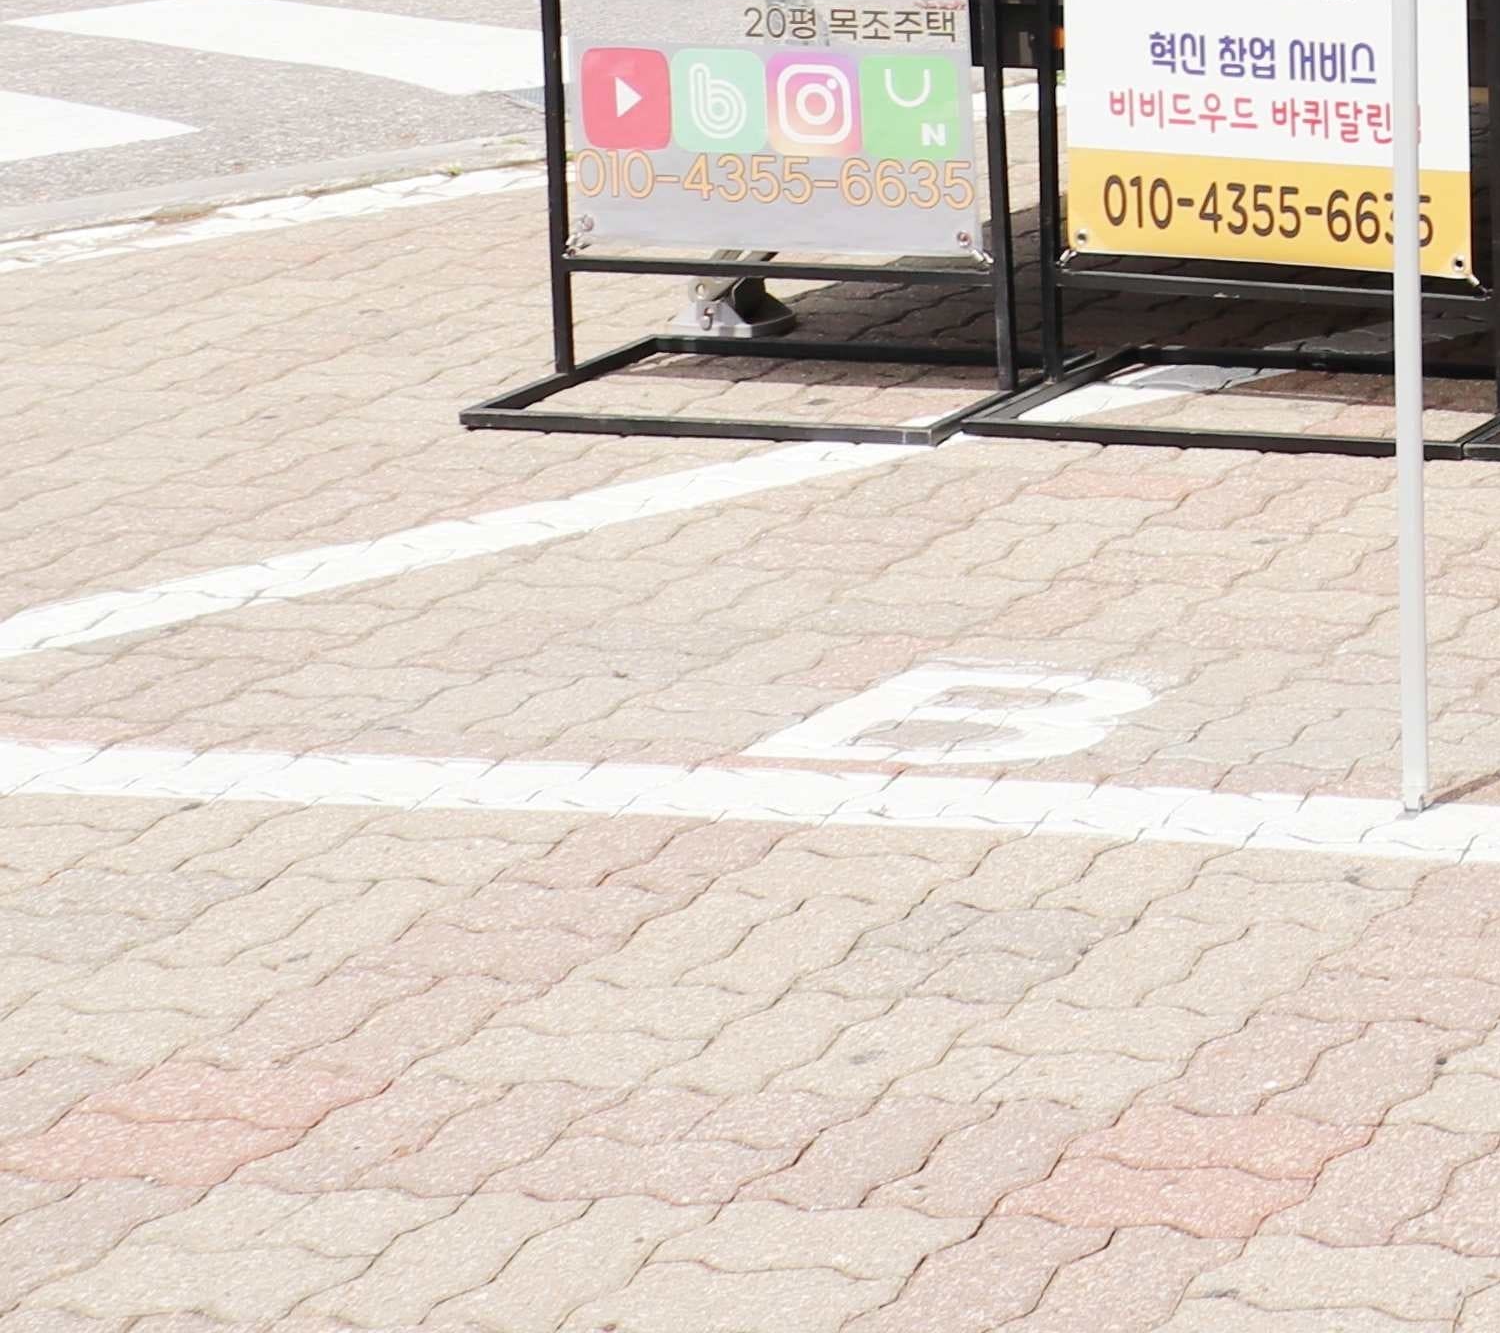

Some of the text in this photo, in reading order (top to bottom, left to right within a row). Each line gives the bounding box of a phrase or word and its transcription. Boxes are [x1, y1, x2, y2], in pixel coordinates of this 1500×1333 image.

[743, 6, 958, 42] 20평 목조주택
[1149, 31, 1377, 84] 혁신 창업 서비스
[1109, 88, 1421, 146] 비비드우드 바퀴달린
[575, 148, 975, 211] 010-4355-6635
